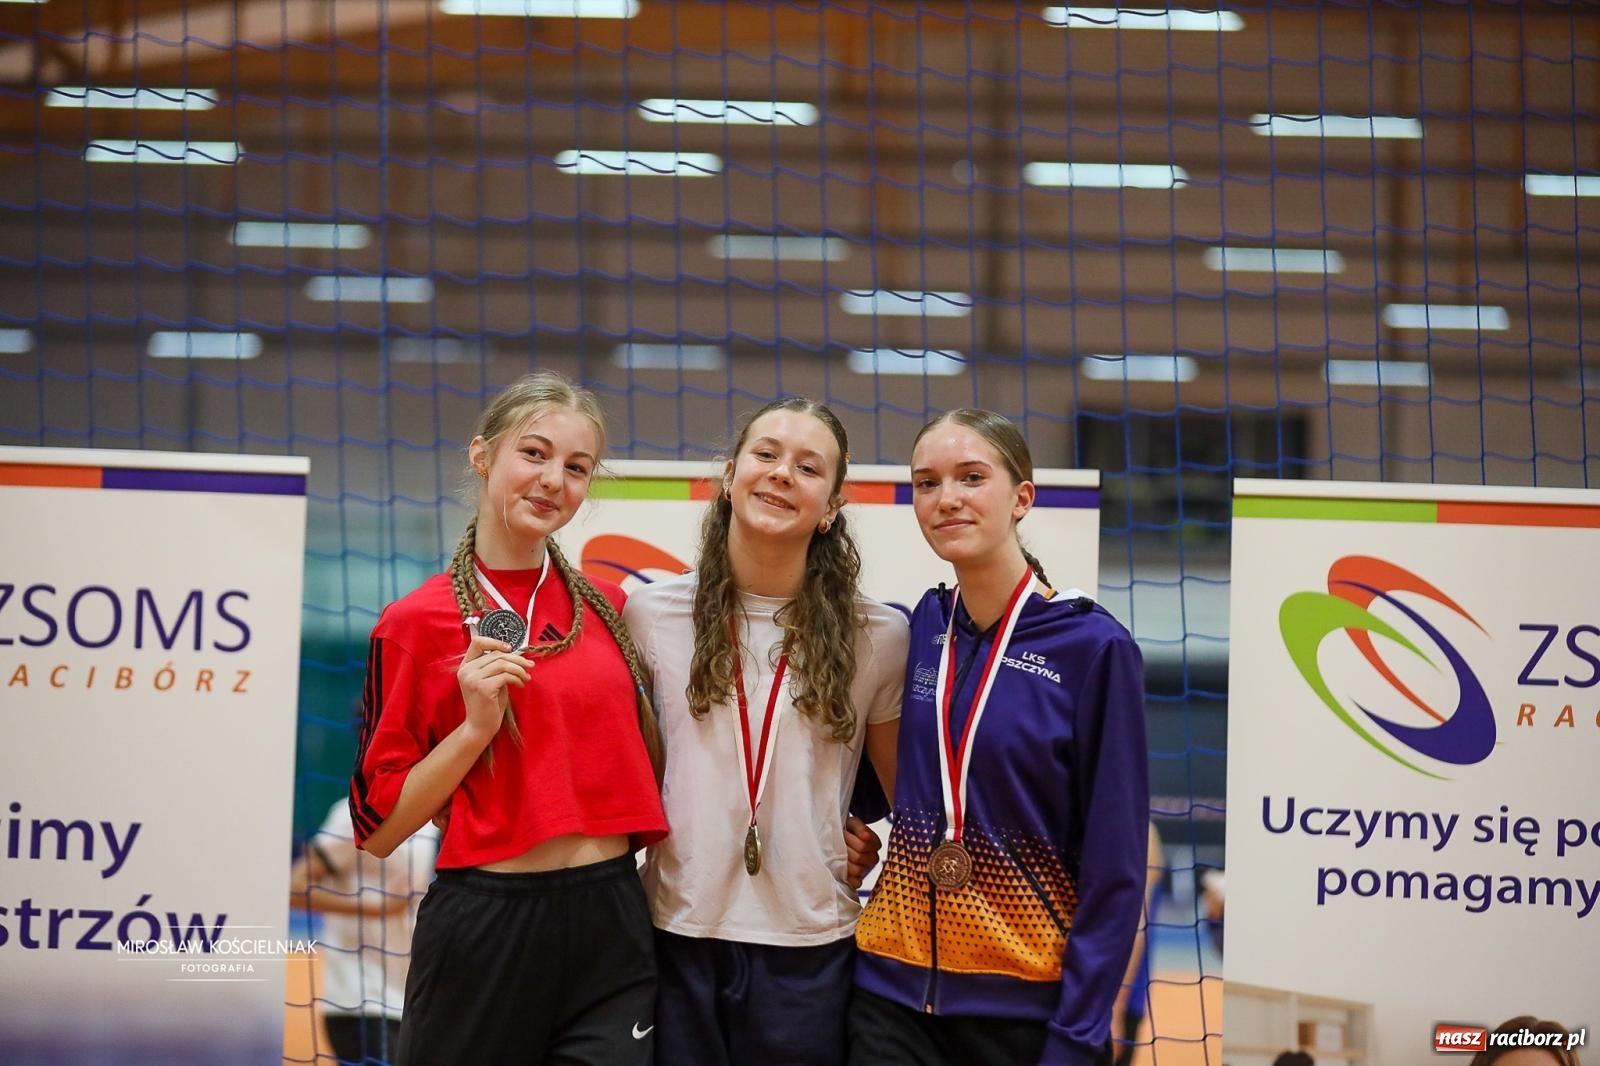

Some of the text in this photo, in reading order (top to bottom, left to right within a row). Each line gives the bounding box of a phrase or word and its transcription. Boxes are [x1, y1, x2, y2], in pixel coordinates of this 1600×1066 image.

[1022, 651, 1046, 665] LKS
[1517, 623, 1600, 688] ZS
[1516, 703, 1600, 728] RA
[0, 801, 142, 879] imy
[1262, 795, 1459, 852] Uczymy
[1473, 805, 1541, 856] się
[1317, 867, 1600, 918] pomagamy
